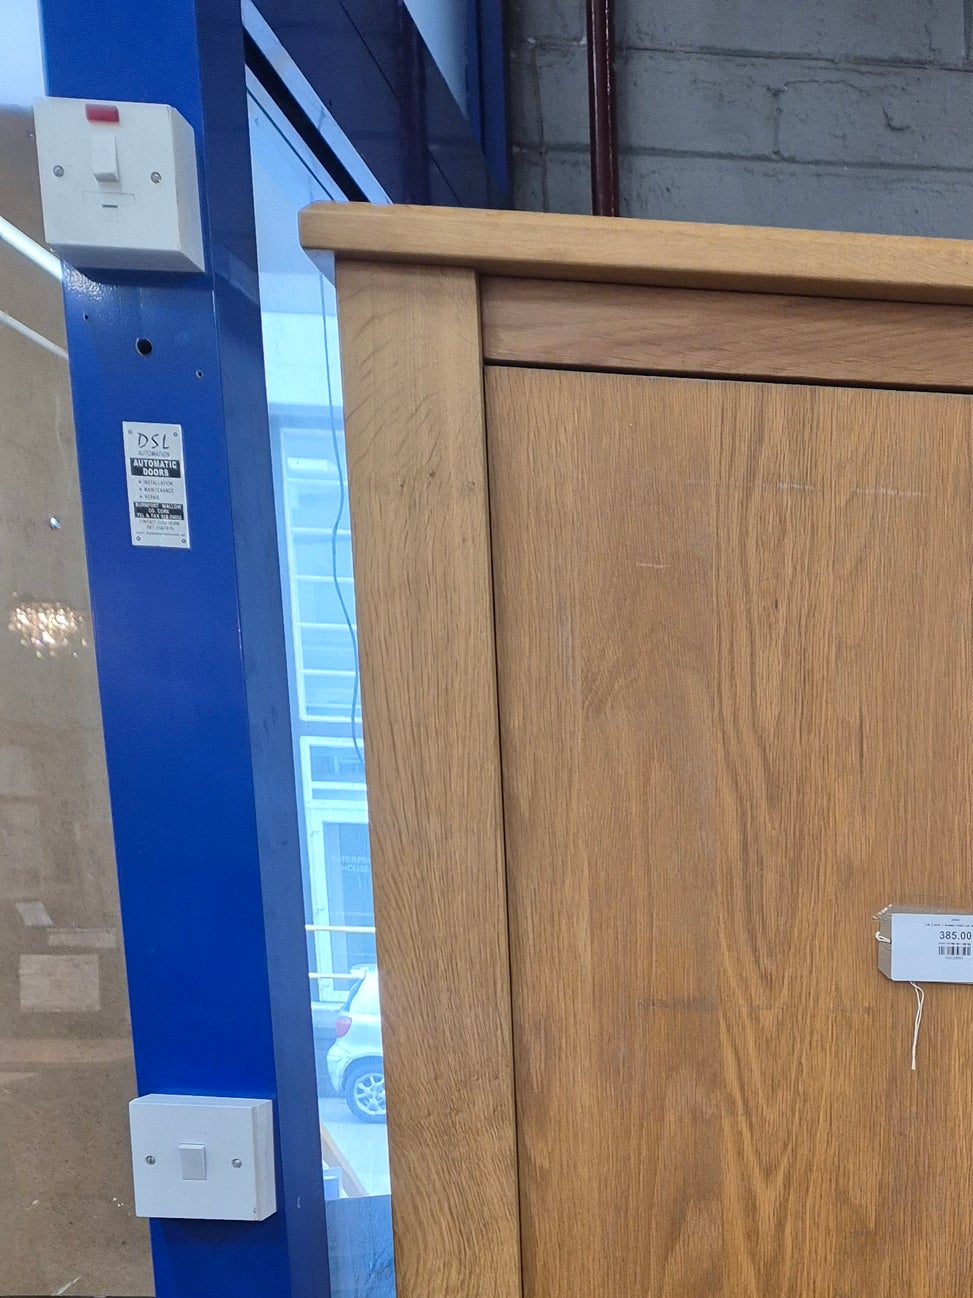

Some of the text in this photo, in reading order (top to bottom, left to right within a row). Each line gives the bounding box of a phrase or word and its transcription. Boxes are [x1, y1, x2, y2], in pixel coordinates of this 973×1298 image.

[137, 432, 170, 449] DSL
[133, 459, 178, 468] AUTOMATIC
[142, 468, 169, 476] DOORS
[939, 931, 972, 940] 385.00
